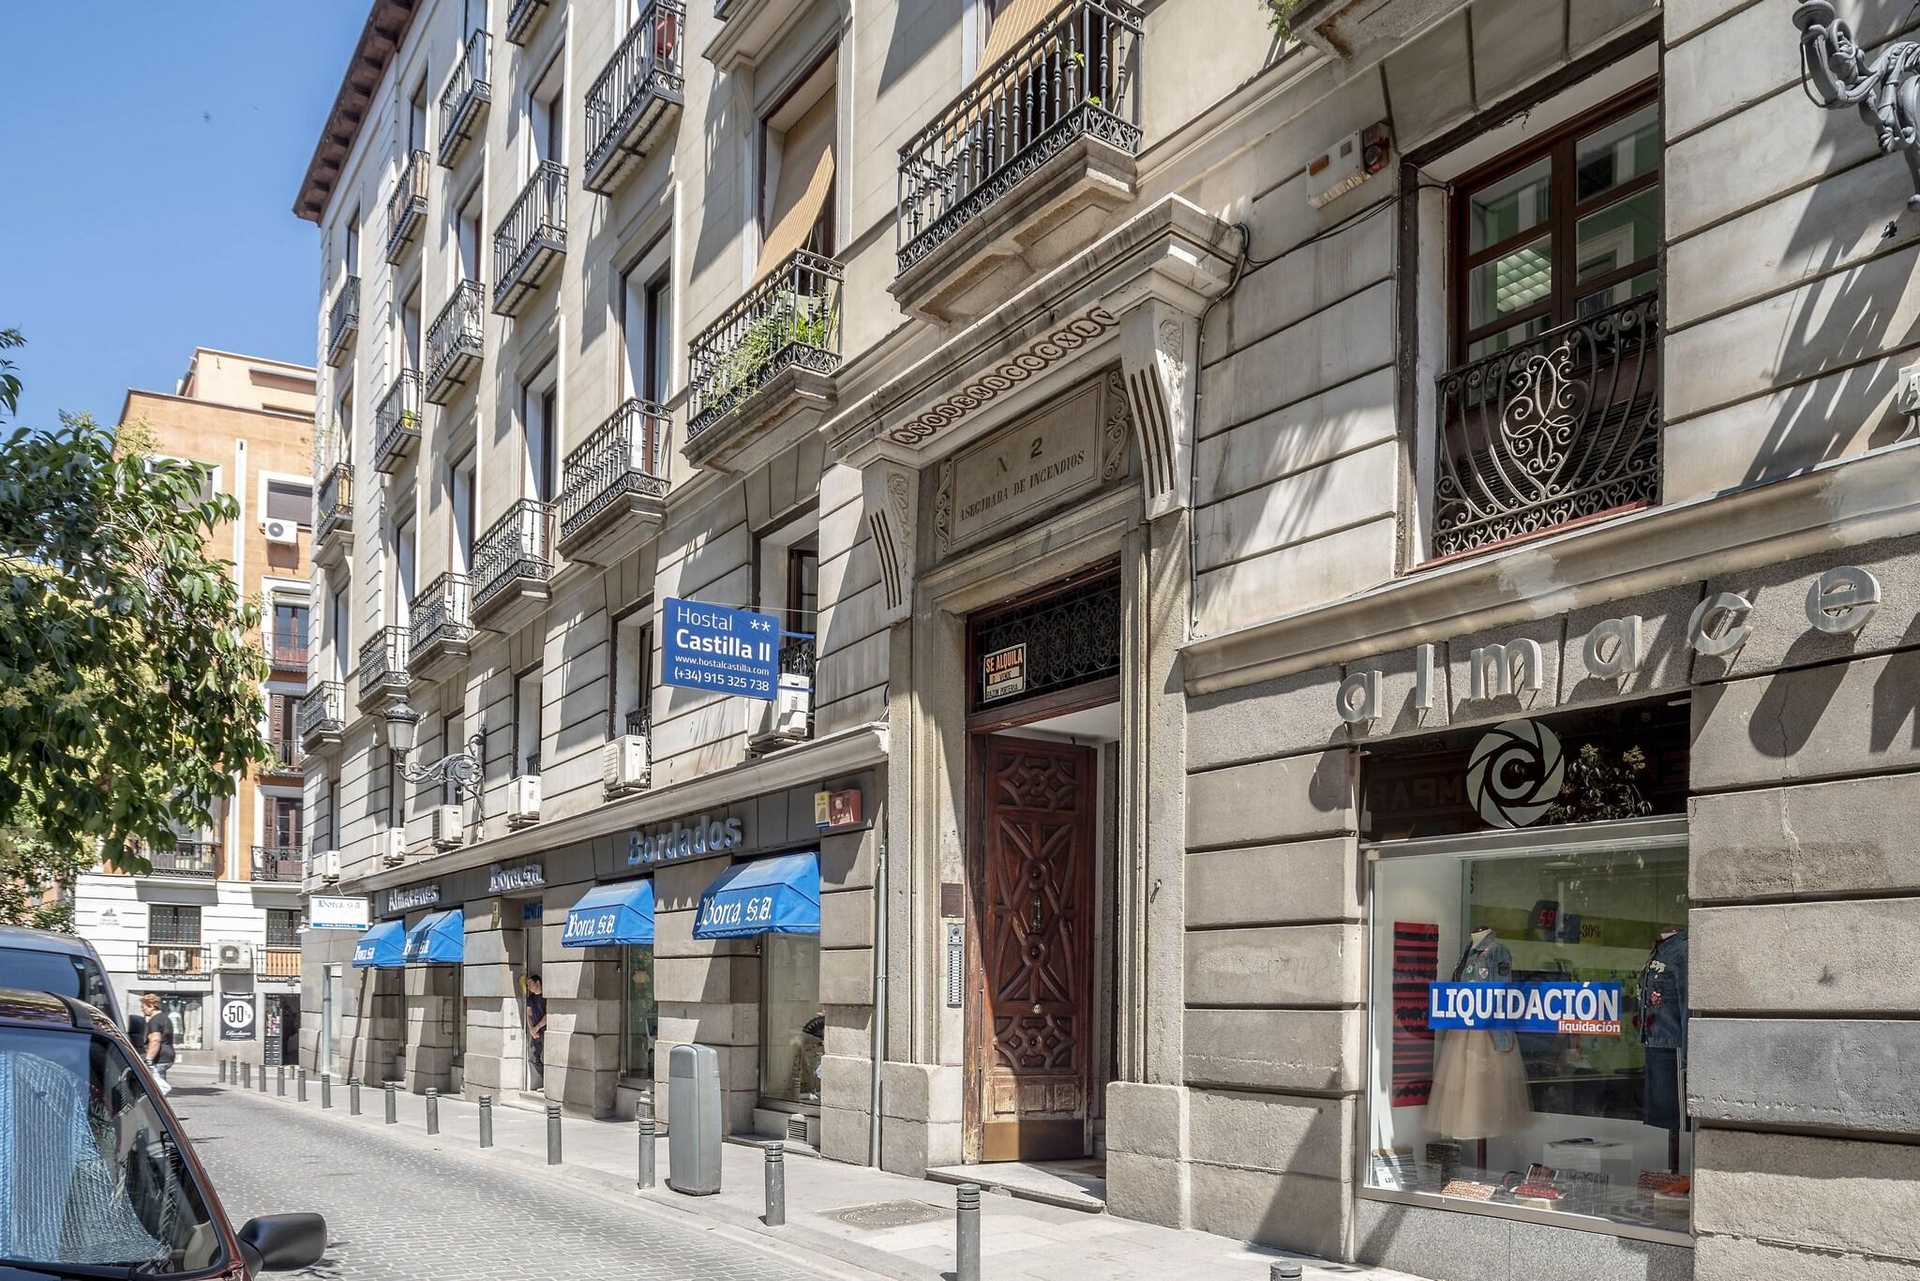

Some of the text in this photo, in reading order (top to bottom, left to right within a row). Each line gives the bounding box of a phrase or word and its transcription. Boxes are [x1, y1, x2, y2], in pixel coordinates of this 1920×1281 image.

[1030, 436, 1043, 459] 2
[1013, 478, 1027, 496] DE
[1030, 450, 1085, 488] INCENDIOS
[677, 606, 733, 631] Hostal
[676, 628, 771, 662] Castilla II
[674, 655, 770, 676] www.hostalcastilla.com
[985, 648, 1023, 673] SE ALQUILA
[674, 666, 770, 692] (+34) 915 325 738
[627, 815, 743, 866] Bordados
[389, 885, 440, 911] Almacenes
[696, 896, 742, 926] Borca,
[564, 912, 595, 938] Borca,
[1431, 982, 1619, 1027] LIQUIDACIÓN
[1558, 1020, 1621, 1034] liquidación
